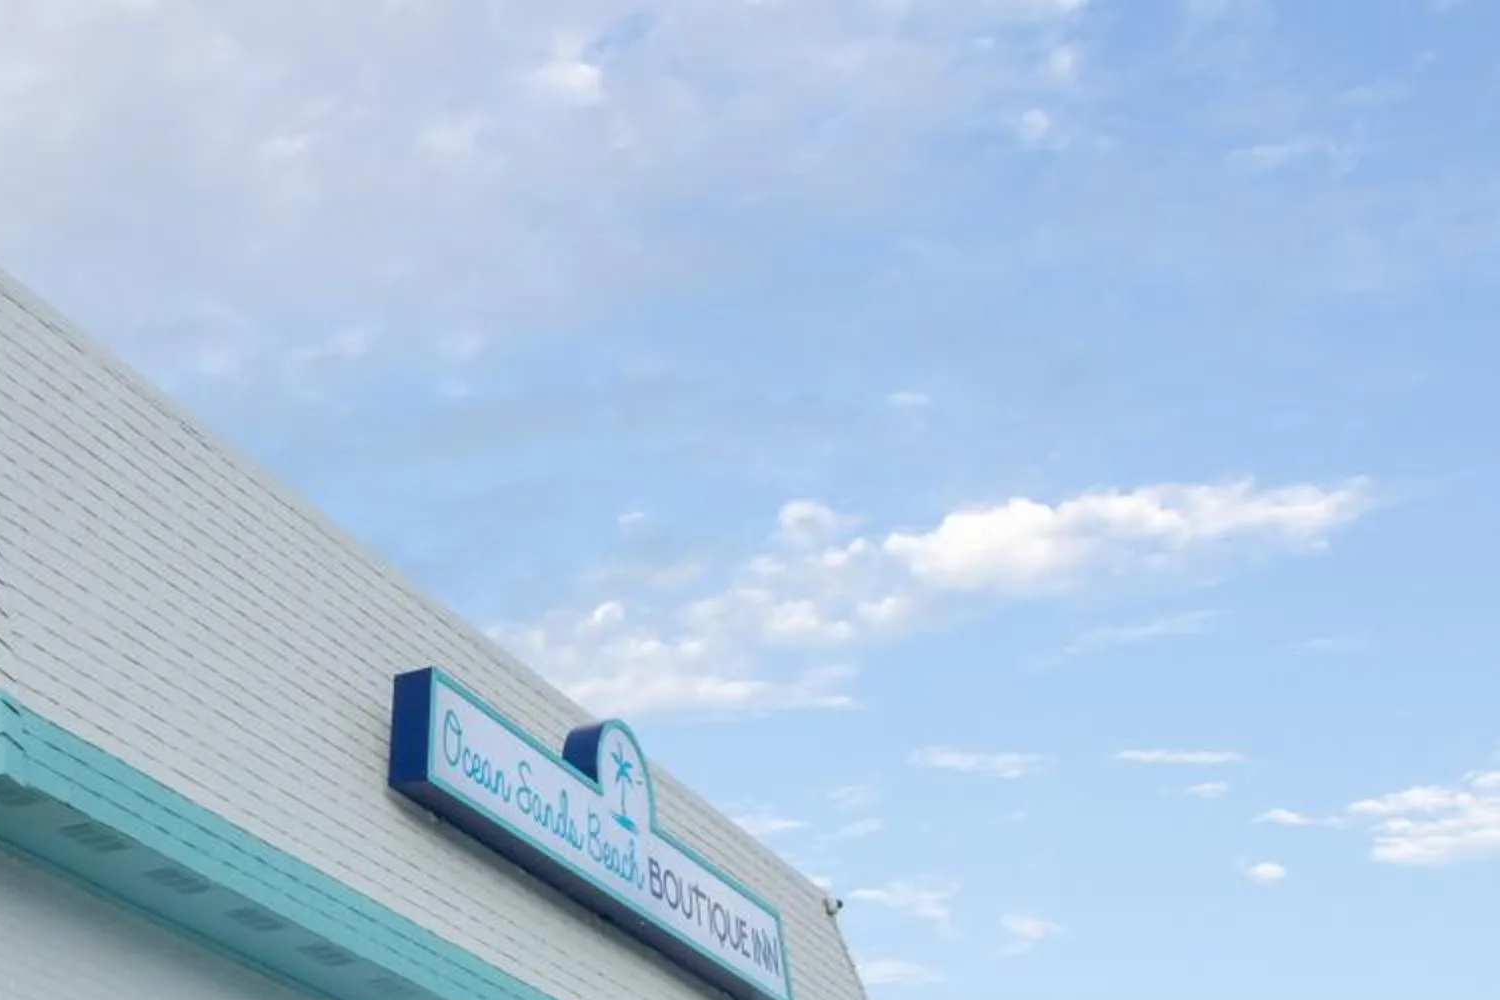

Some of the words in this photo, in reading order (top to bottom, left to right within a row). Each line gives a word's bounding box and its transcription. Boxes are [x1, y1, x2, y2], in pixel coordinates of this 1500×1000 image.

[443, 709, 512, 803] Ocean
[516, 760, 584, 851] Sands
[587, 806, 646, 890] Beach
[648, 856, 751, 958] BOUTIQUE
[751, 926, 780, 977] INN
